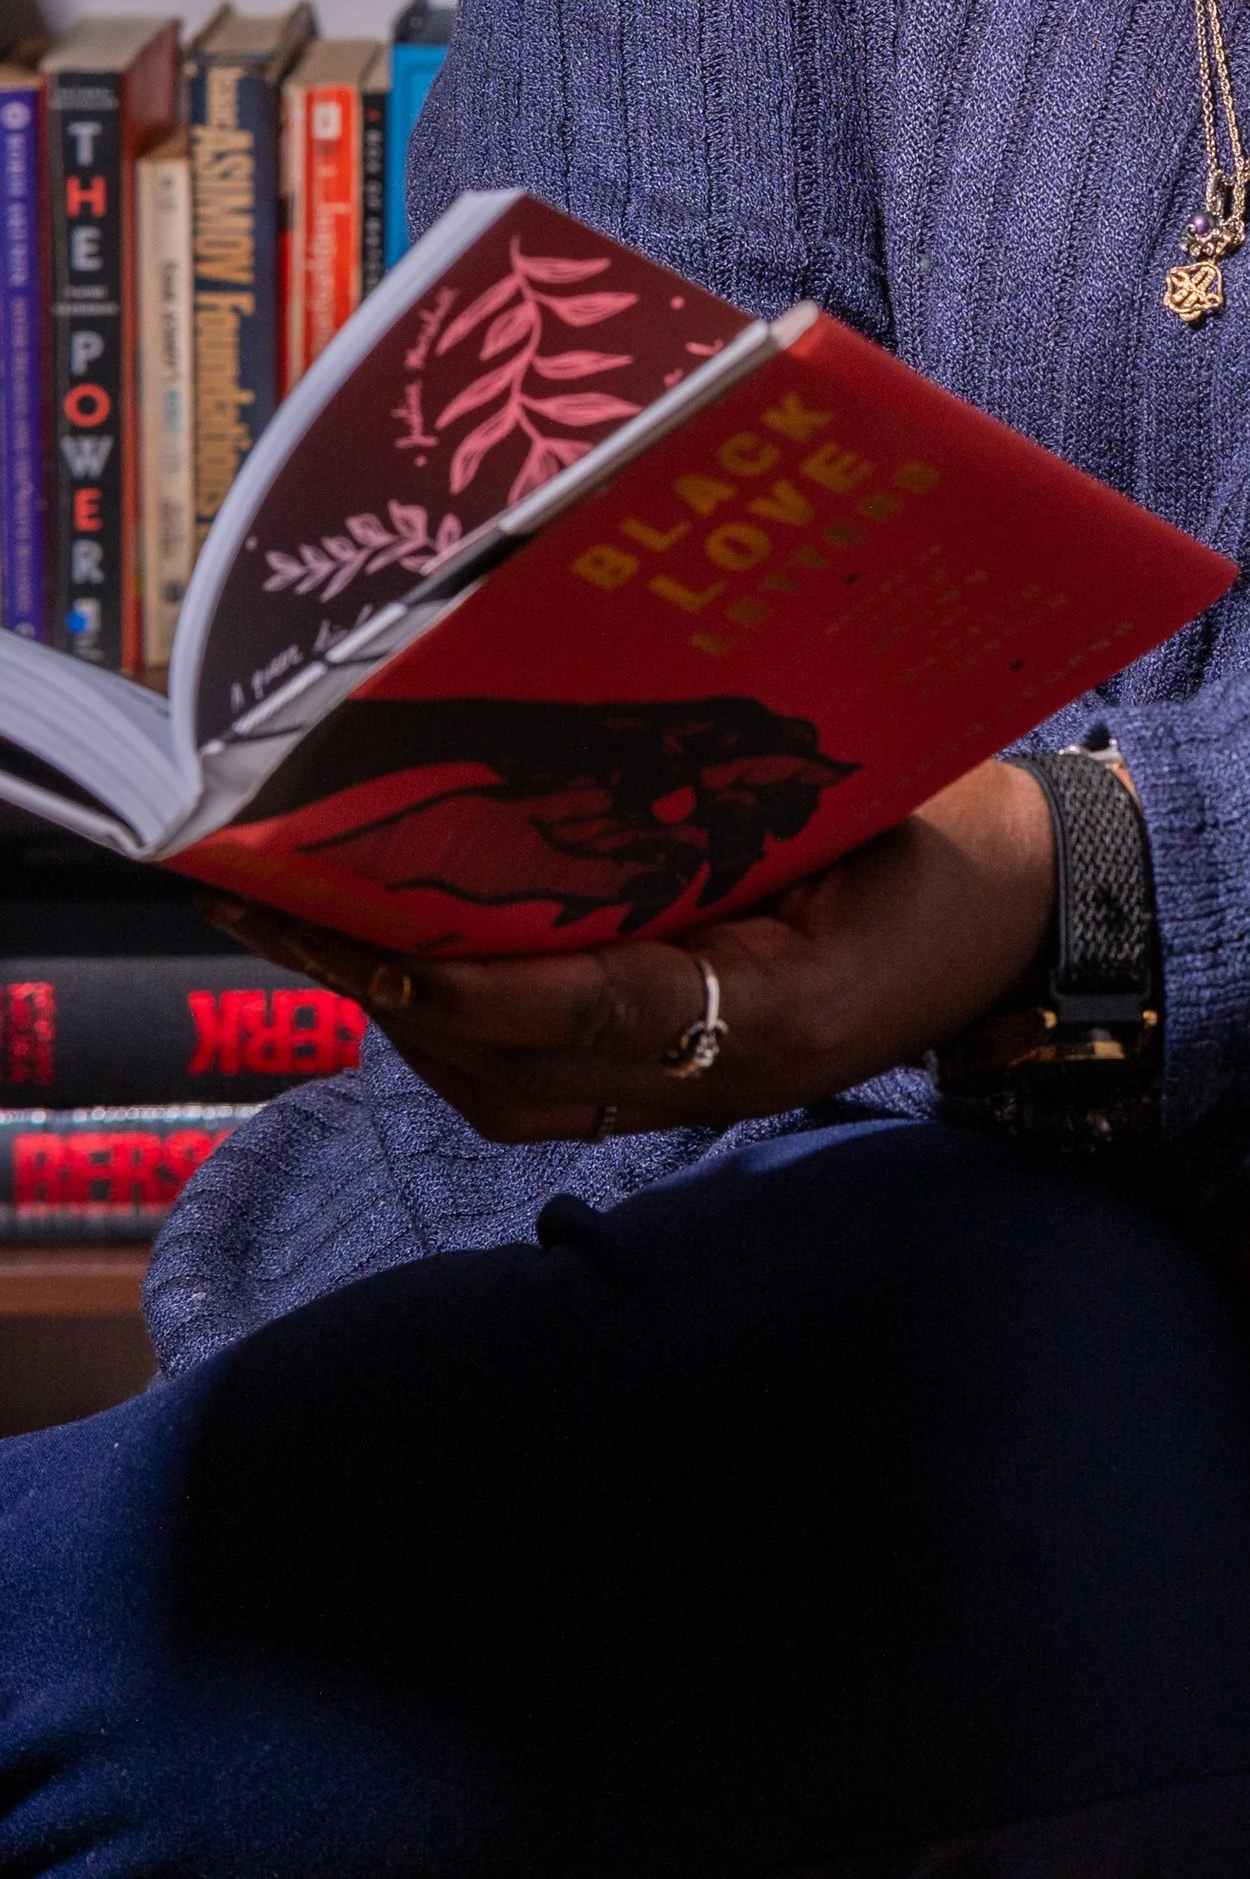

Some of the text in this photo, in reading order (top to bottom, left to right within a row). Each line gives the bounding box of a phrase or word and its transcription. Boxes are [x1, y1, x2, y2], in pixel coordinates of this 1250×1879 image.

[65, 121, 108, 273] THE
[192, 126, 255, 285] ASIMOV
[62, 330, 114, 587] POWER
[568, 390, 834, 592] BLACK
[646, 440, 876, 615] LOVE
